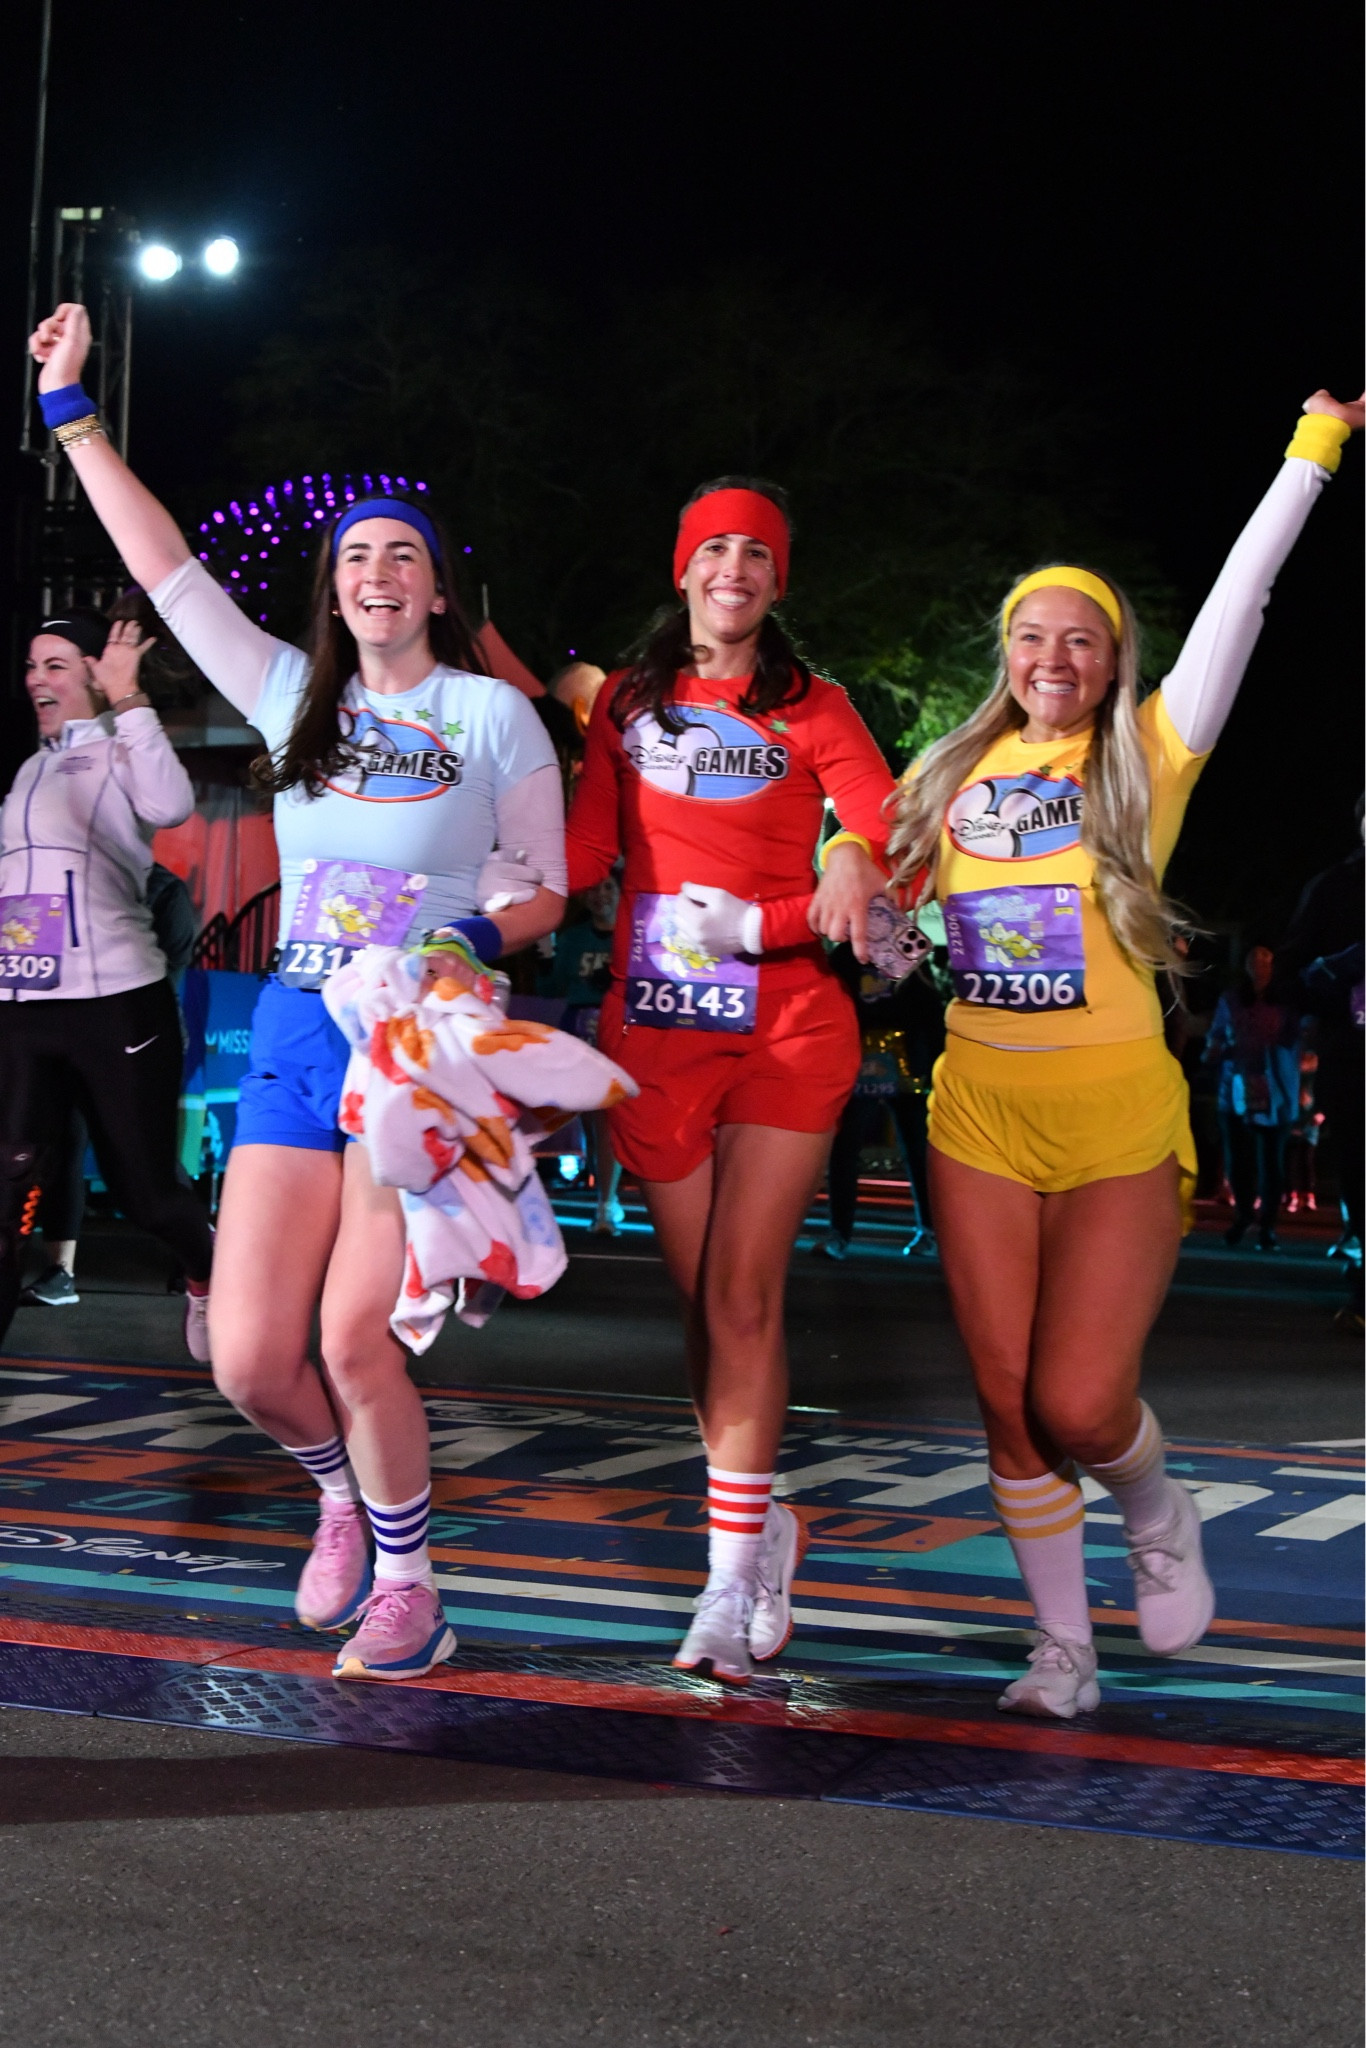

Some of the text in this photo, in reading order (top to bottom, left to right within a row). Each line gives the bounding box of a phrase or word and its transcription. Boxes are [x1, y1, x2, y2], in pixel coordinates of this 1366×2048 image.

[368, 751, 461, 784] GAMES
[694, 746, 788, 779] GAMES
[1016, 797, 1084, 843] GAME
[1055, 887, 1070, 903] D
[631, 919, 646, 962] 26143
[946, 913, 965, 956] 22306
[285, 942, 347, 976] 231
[635, 980, 746, 1019] 26143
[963, 972, 1076, 1006] 22306
